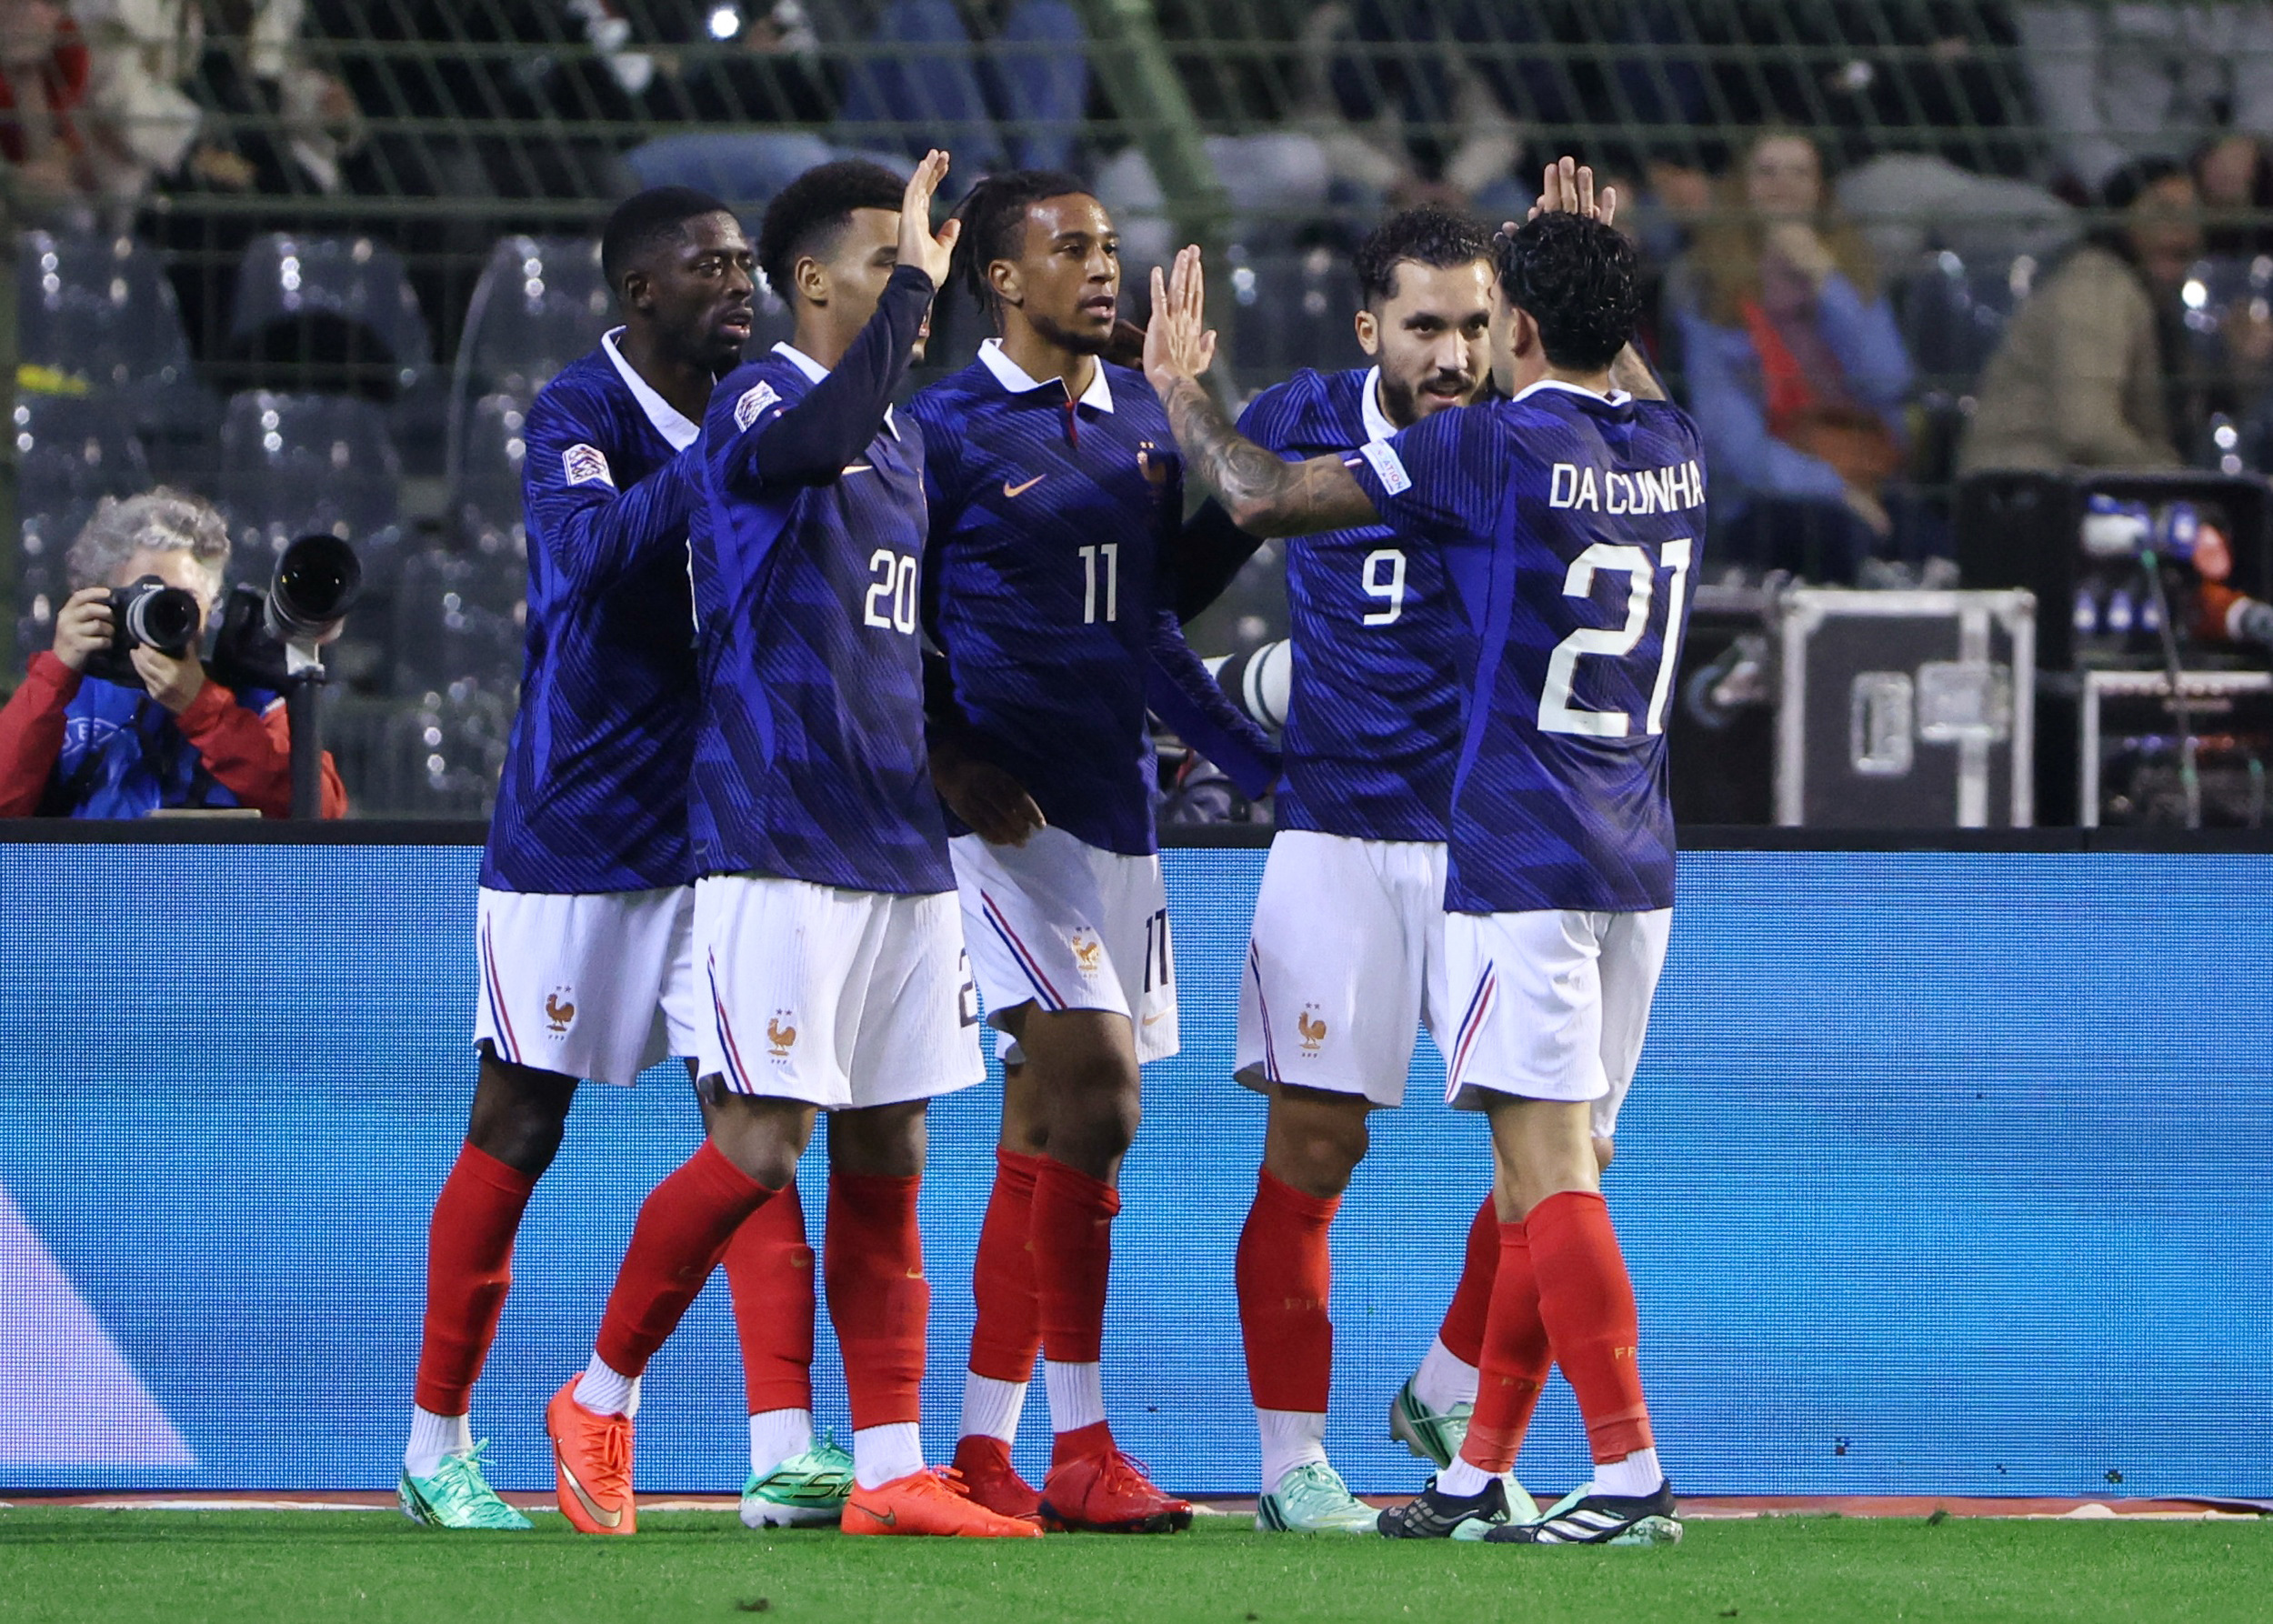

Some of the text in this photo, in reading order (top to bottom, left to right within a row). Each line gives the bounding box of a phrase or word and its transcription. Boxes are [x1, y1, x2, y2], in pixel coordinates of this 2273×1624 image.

[1549, 459, 1706, 515] DA CUNHA
[864, 548, 917, 635] 20
[1078, 543, 1118, 624] 11
[1361, 549, 1407, 626] 9
[1537, 537, 1693, 737] 21
[1144, 907, 1169, 993] 11
